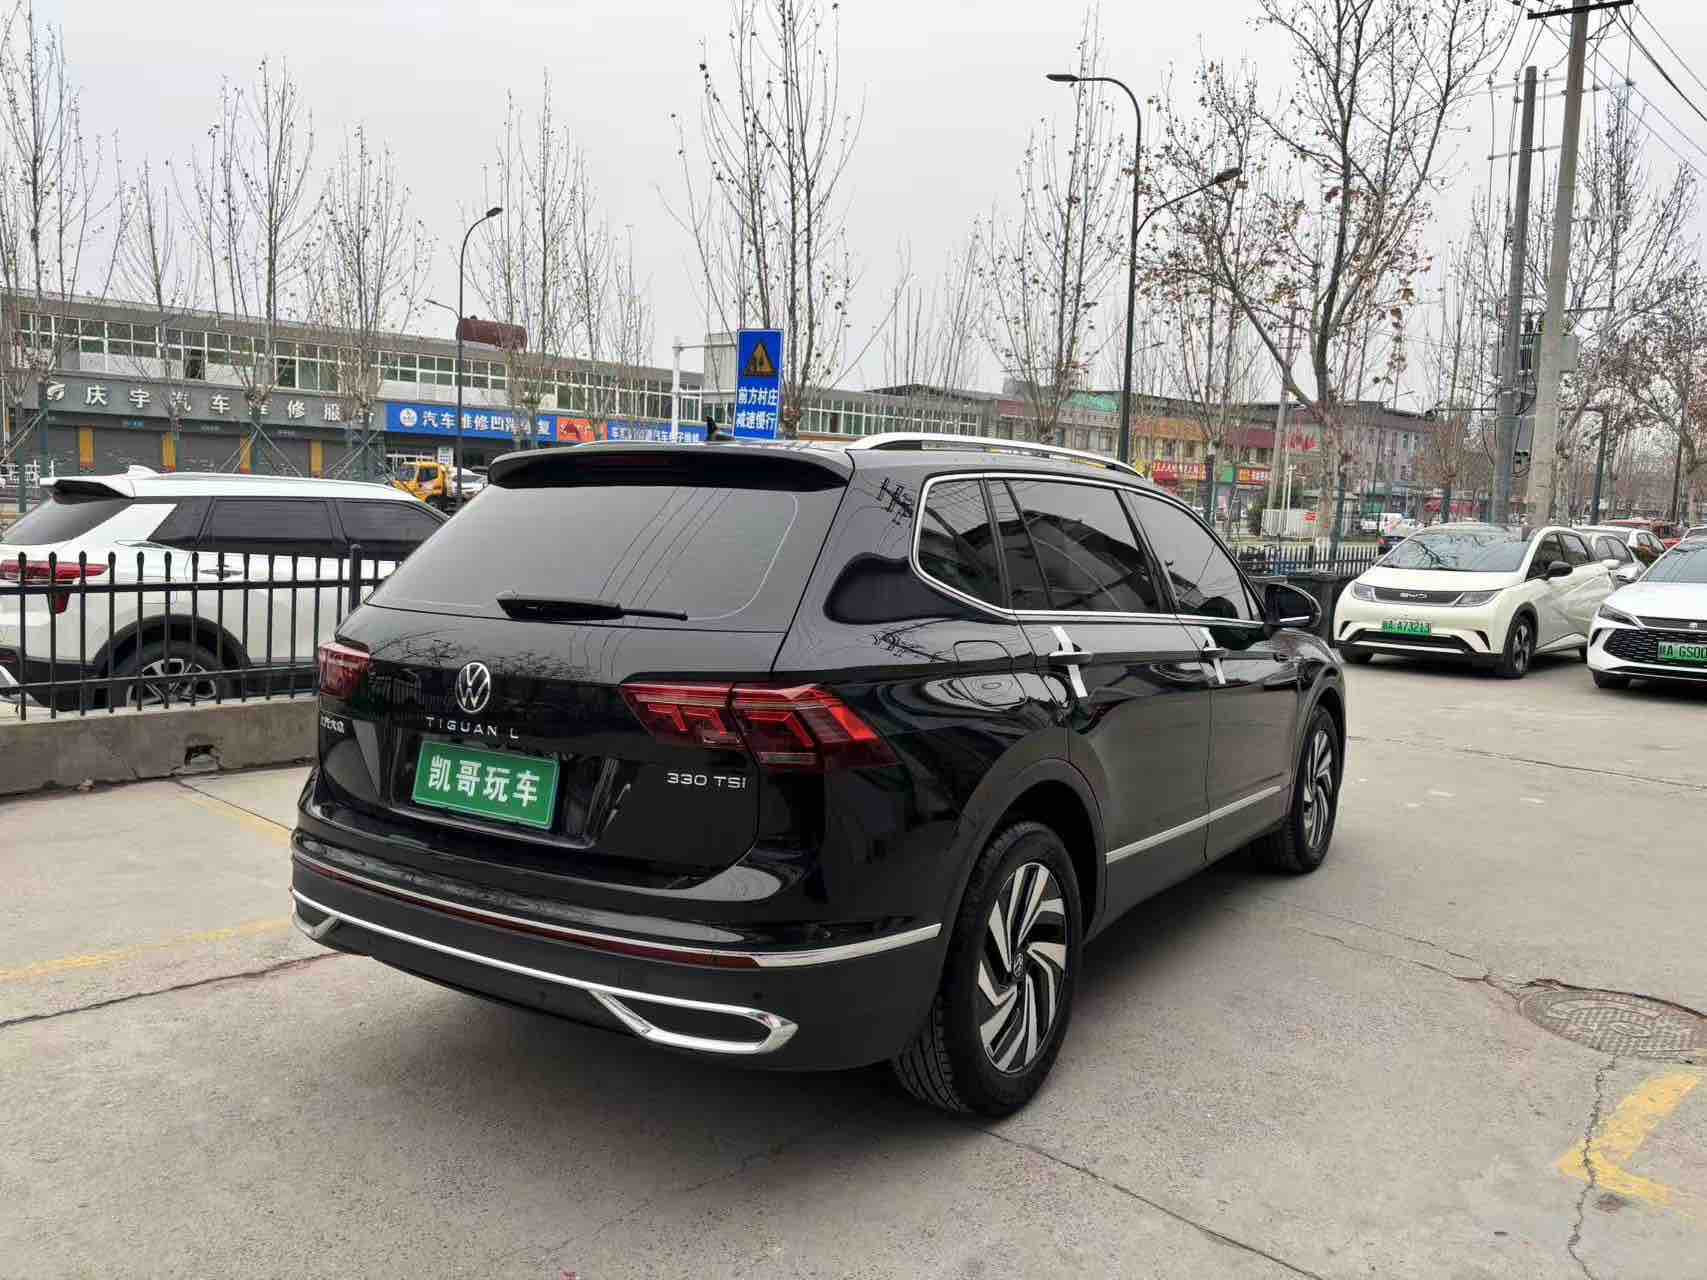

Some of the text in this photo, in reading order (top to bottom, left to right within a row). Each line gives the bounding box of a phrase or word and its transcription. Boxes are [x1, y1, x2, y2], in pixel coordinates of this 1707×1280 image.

[738, 386, 778, 405] 前方村庄
[736, 411, 777, 430] 减速慢行
[426, 716, 520, 739] TIGUAN L
[428, 755, 540, 808] 凯哥玩车
[666, 772, 746, 789] 330 TSI
